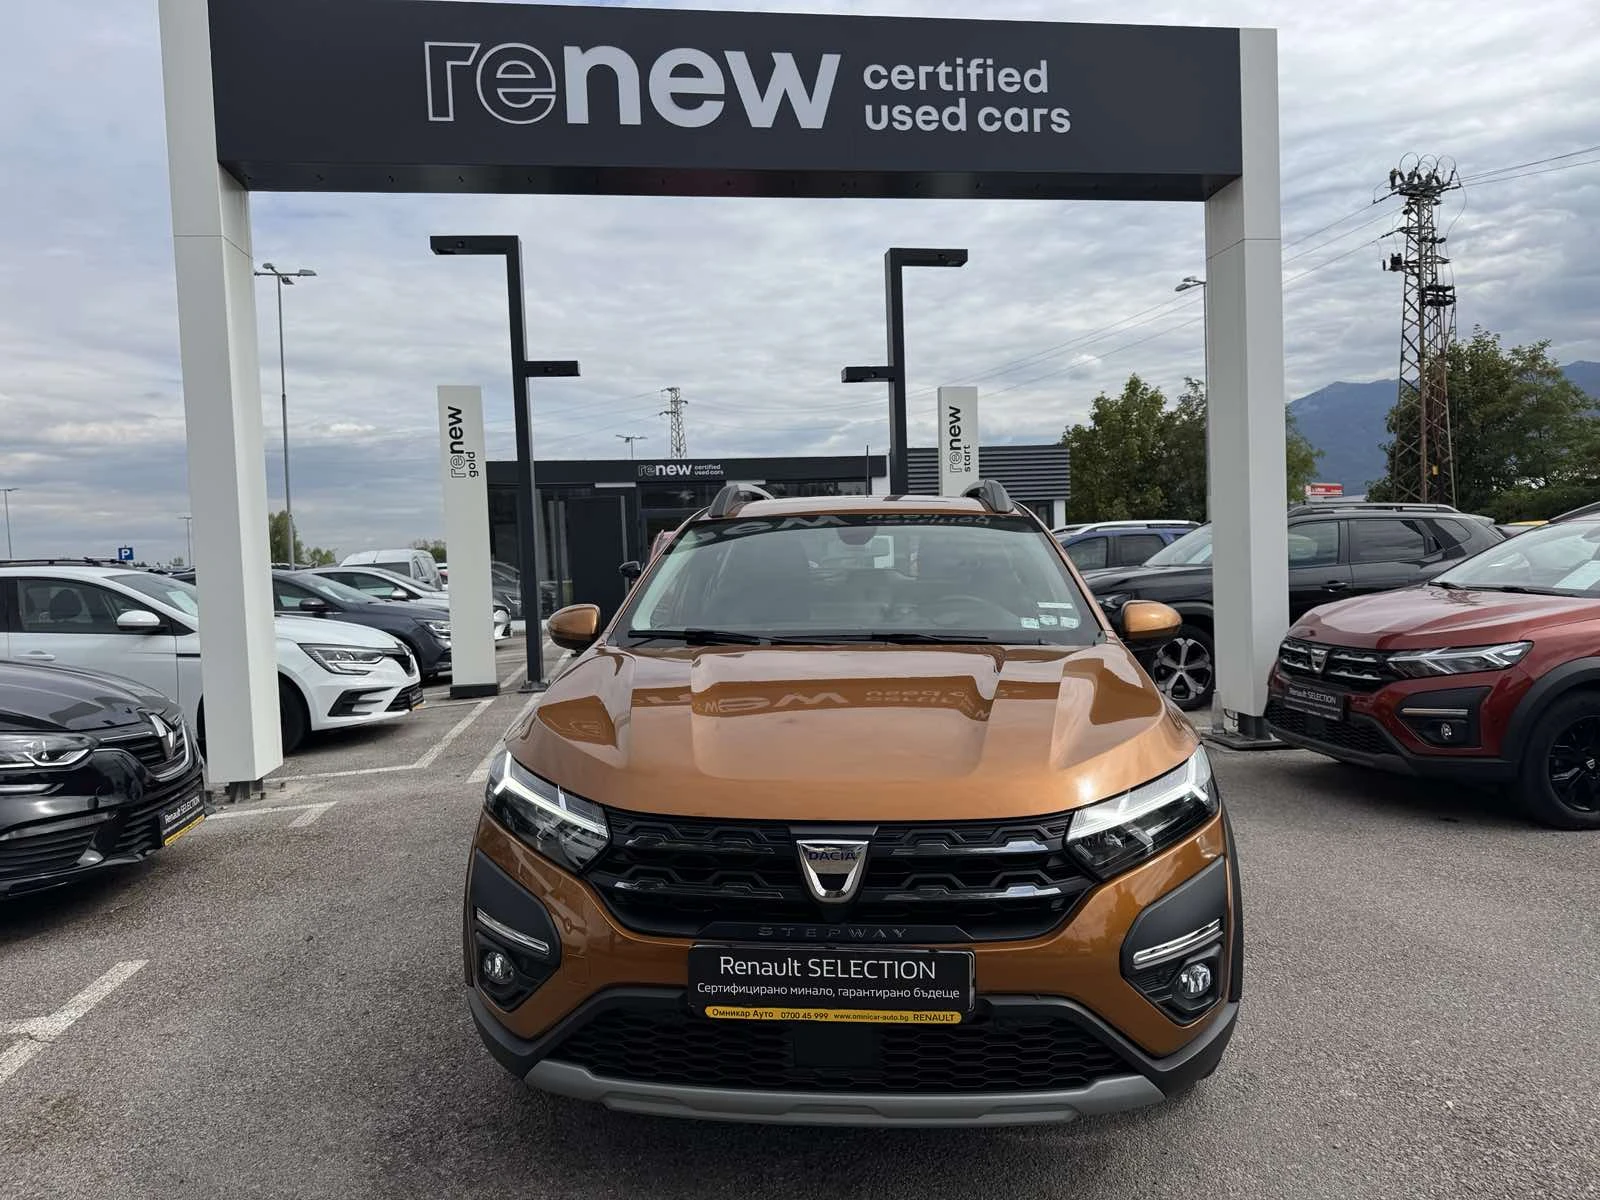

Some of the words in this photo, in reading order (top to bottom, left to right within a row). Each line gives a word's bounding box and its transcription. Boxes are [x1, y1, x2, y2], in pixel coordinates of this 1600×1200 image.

[424, 41, 842, 129] renew
[863, 57, 1049, 93] certified
[865, 97, 967, 132] used
[977, 105, 1071, 133] cars
[447, 405, 466, 478] renew
[948, 405, 962, 473] renew
[465, 451, 479, 478] gold
[963, 443, 971, 473] start
[638, 464, 692, 476] renew
[121, 549, 130, 559] P
[808, 850, 856, 861] DACIA
[758, 926, 907, 938] STEPWAY
[719, 956, 801, 977] Renault
[807, 958, 936, 979] SELECTION
[697, 982, 788, 996] Сертифицирано
[790, 986, 835, 998] минало,
[838, 988, 911, 999] гарантирано
[913, 987, 960, 999] бъдеще
[712, 1008, 750, 1018] Омникар
[752, 1010, 774, 1018] Ауто
[780, 1011, 800, 1019] 0700
[814, 1012, 829, 1020] 999
[833, 1013, 909, 1022] www.omnicar-auto.bg
[912, 1013, 955, 1022] RENAULT
